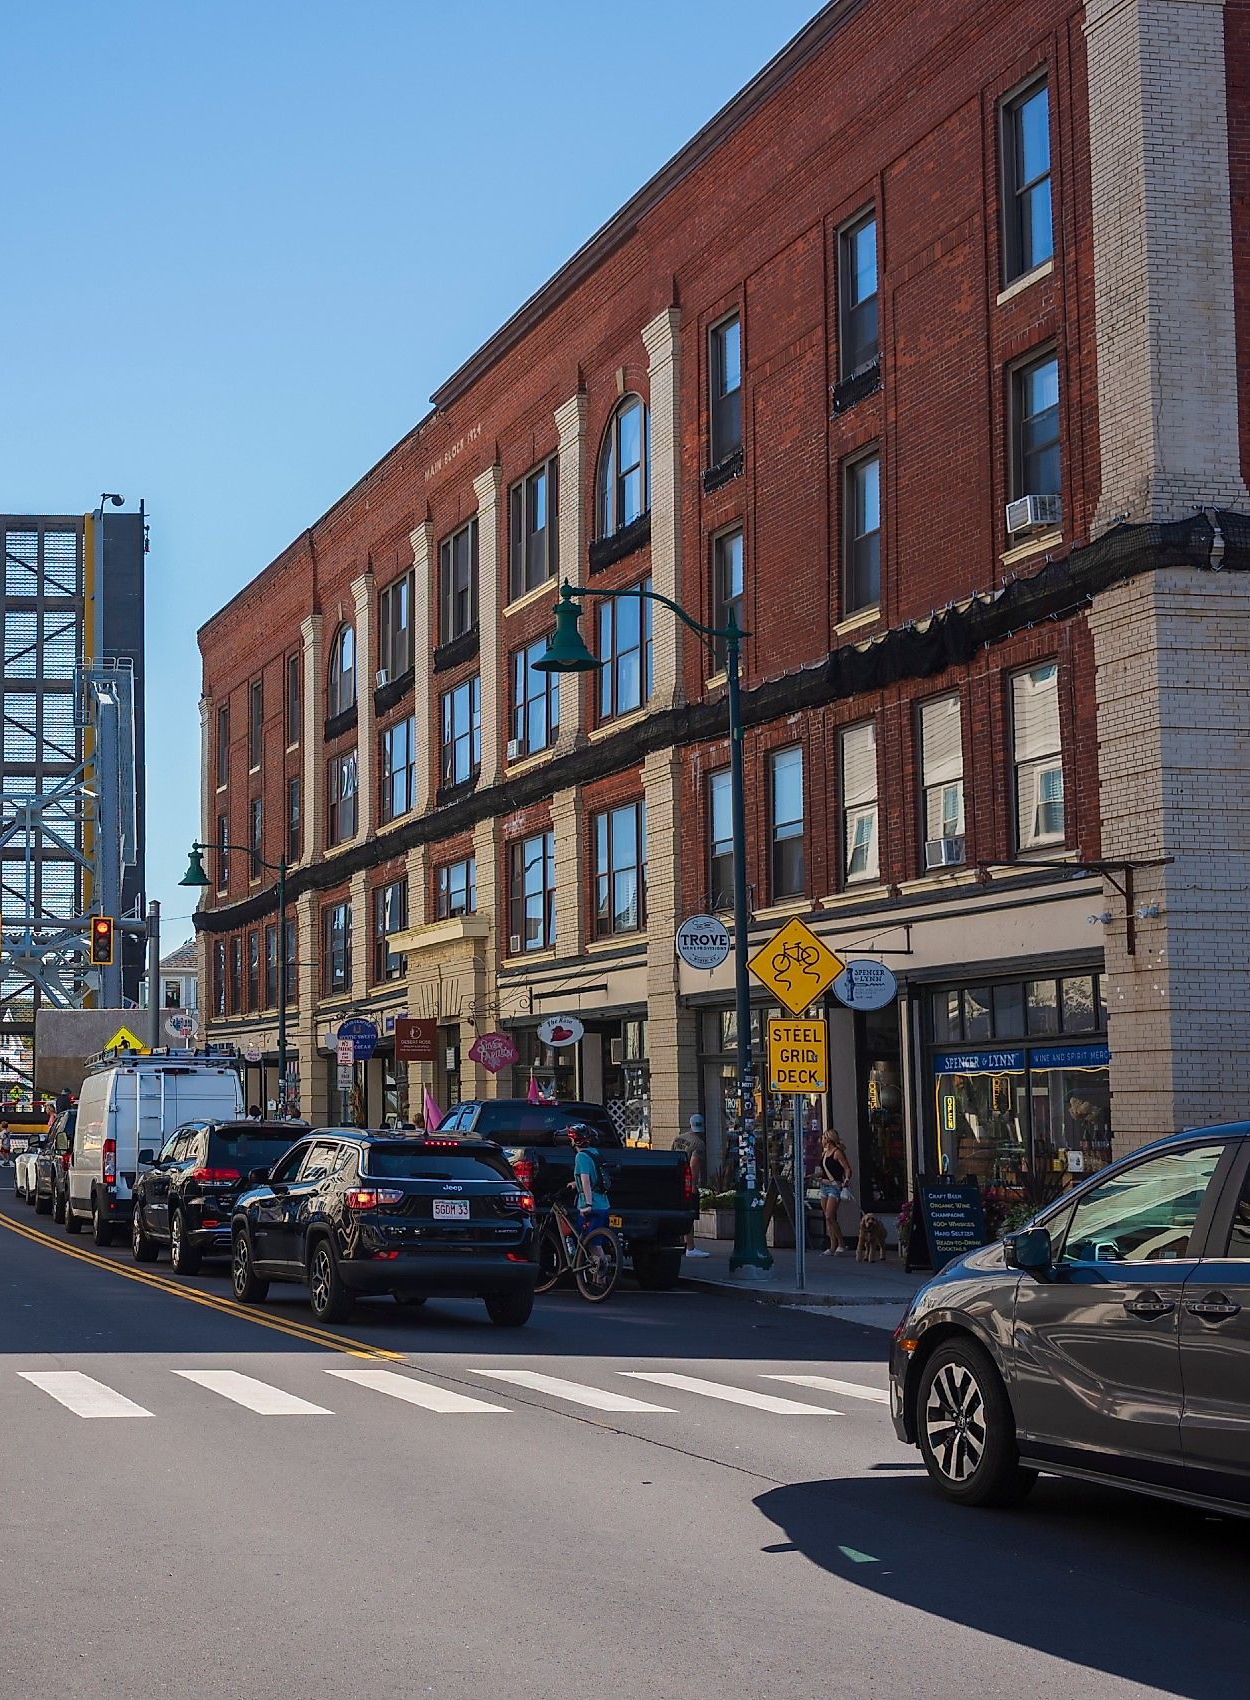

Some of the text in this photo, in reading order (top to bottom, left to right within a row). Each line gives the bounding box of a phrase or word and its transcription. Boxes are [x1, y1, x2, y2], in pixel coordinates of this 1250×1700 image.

[444, 437, 464, 465] BLOCK
[680, 934, 728, 946] TROVE
[773, 1029, 822, 1042] STEEL
[780, 1049, 818, 1063] GRID
[945, 1056, 979, 1069] SPENCER
[989, 1053, 1016, 1067] LYNN
[1034, 1054, 1050, 1063] WINE
[1053, 1053, 1065, 1061] AND
[1067, 1051, 1087, 1061] SPIRIT
[777, 1069, 818, 1083] DECK
[946, 1097, 954, 1128] OPEN
[435, 1204, 456, 1215] 5GDM
